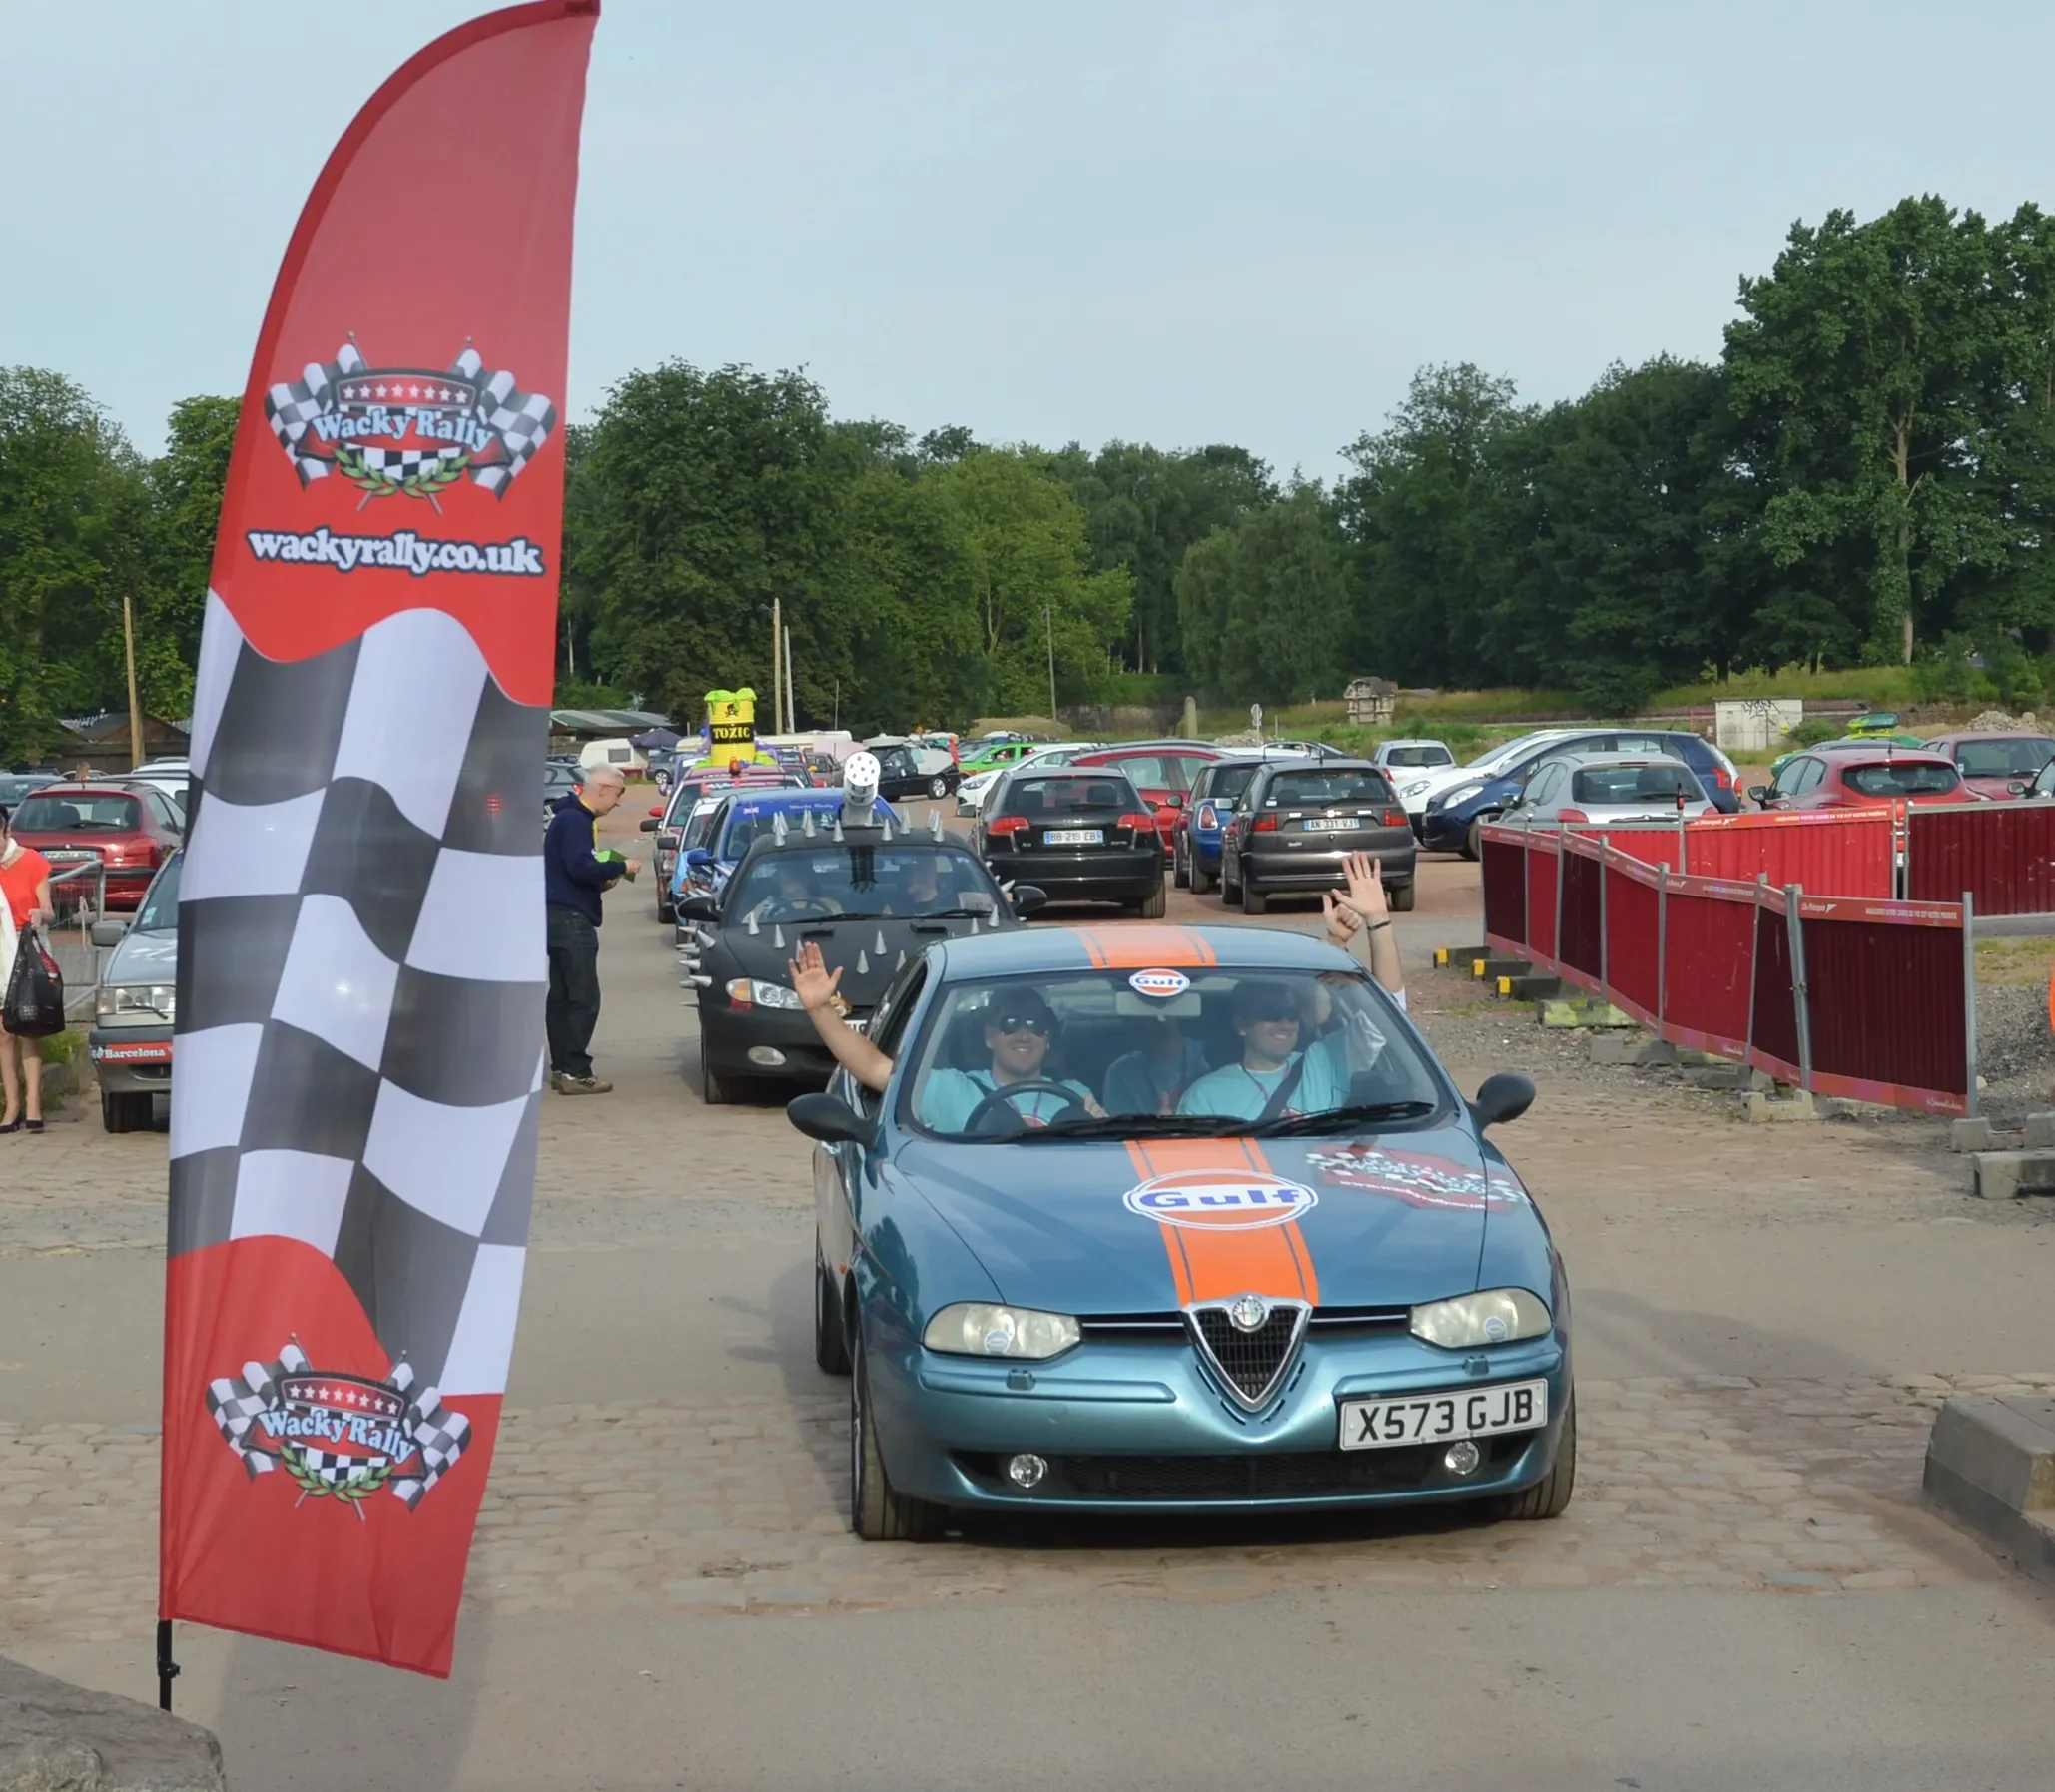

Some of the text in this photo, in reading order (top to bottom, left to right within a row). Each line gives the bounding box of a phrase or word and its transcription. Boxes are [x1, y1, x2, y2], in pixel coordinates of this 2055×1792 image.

[312, 408, 495, 451] Wacky Rally
[248, 527, 543, 574] wackyrally.co.uk
[712, 726, 751, 739] TOXIC
[1134, 976, 1184, 986] Gulf
[104, 1048, 166, 1059] Barcelona
[1138, 1189, 1299, 1208] Gulf
[1357, 1388, 1533, 1442] X573 GJB
[258, 1409, 416, 1463] Wacky Rally
